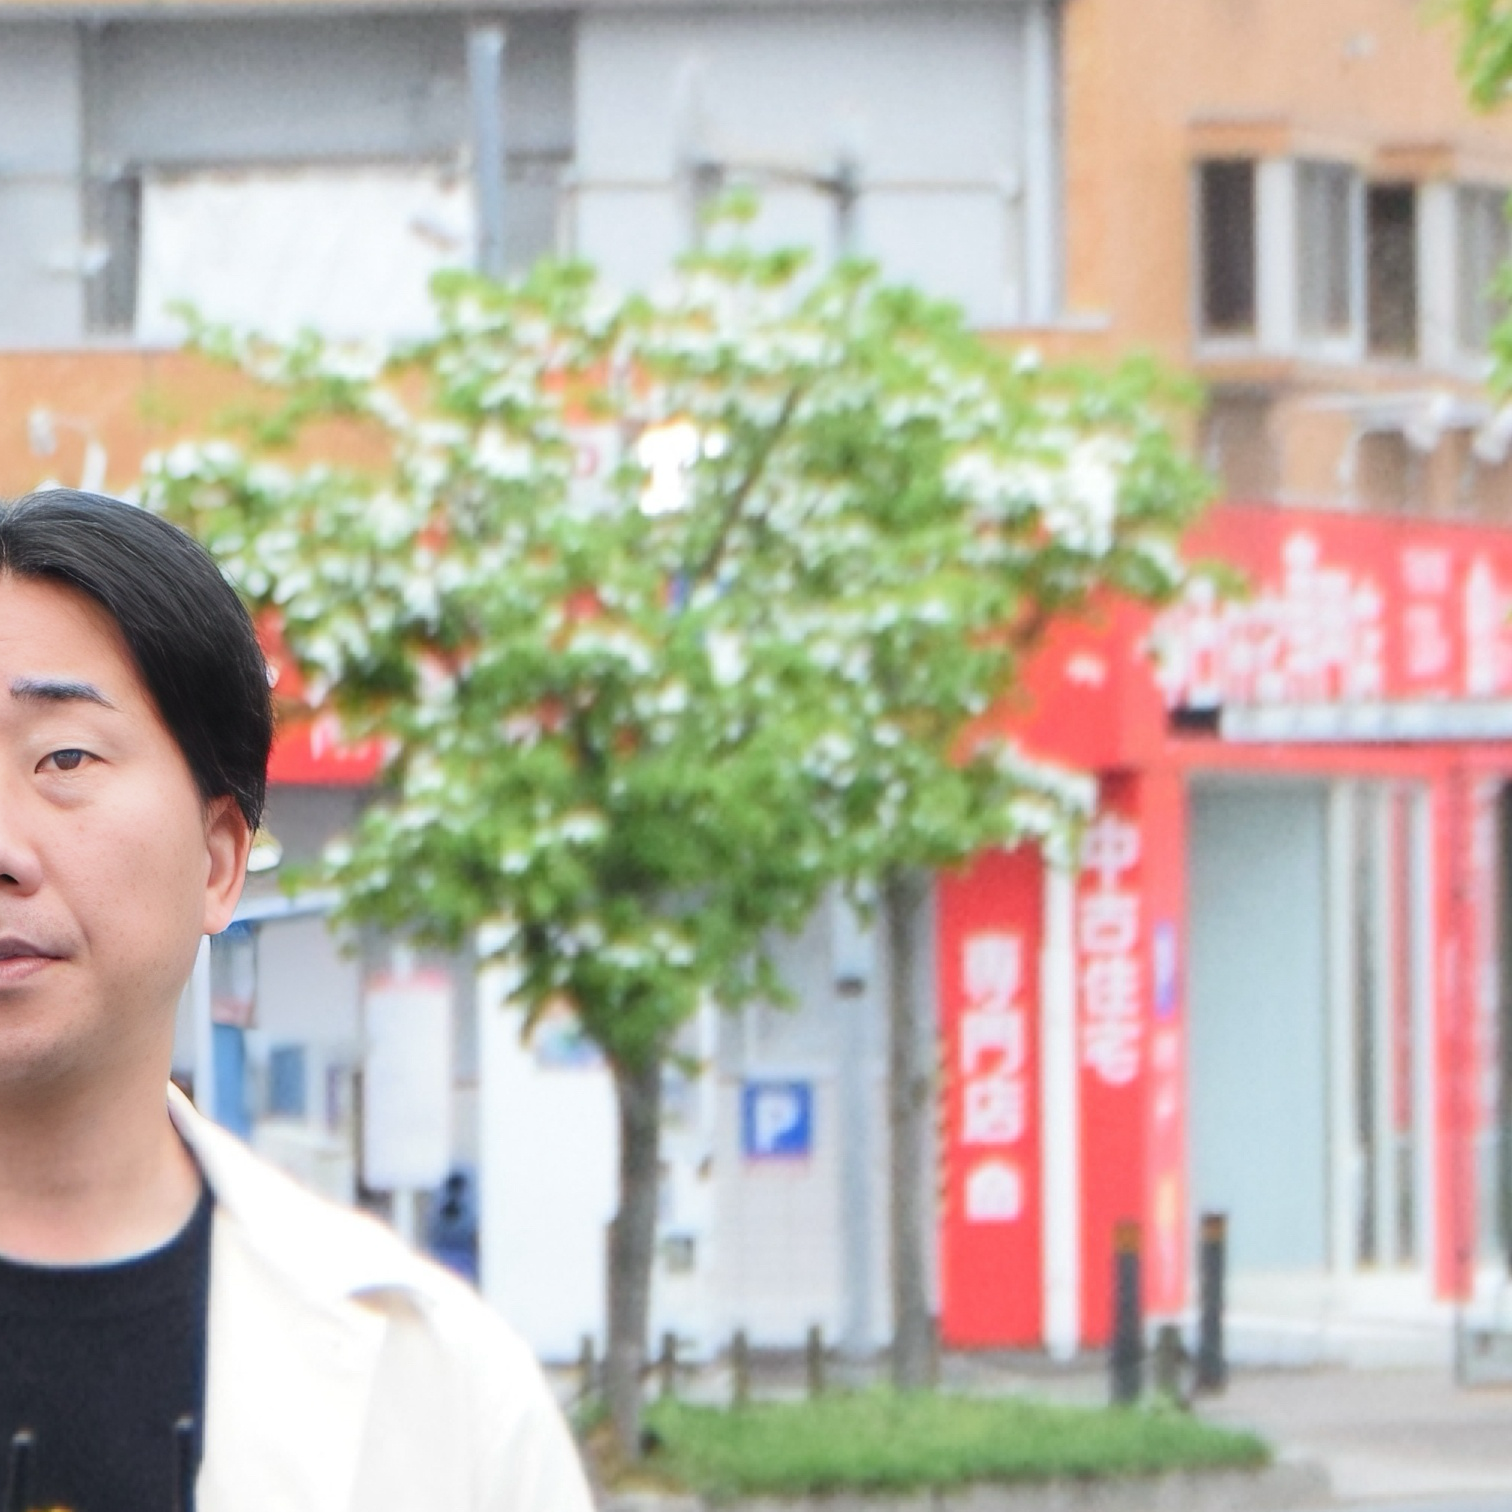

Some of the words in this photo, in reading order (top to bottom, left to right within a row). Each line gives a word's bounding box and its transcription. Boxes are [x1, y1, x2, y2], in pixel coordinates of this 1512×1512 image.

[960, 933, 1026, 1144] 専門店
[1081, 811, 1141, 1085] 中古住宅
[754, 1094, 801, 1152] P
